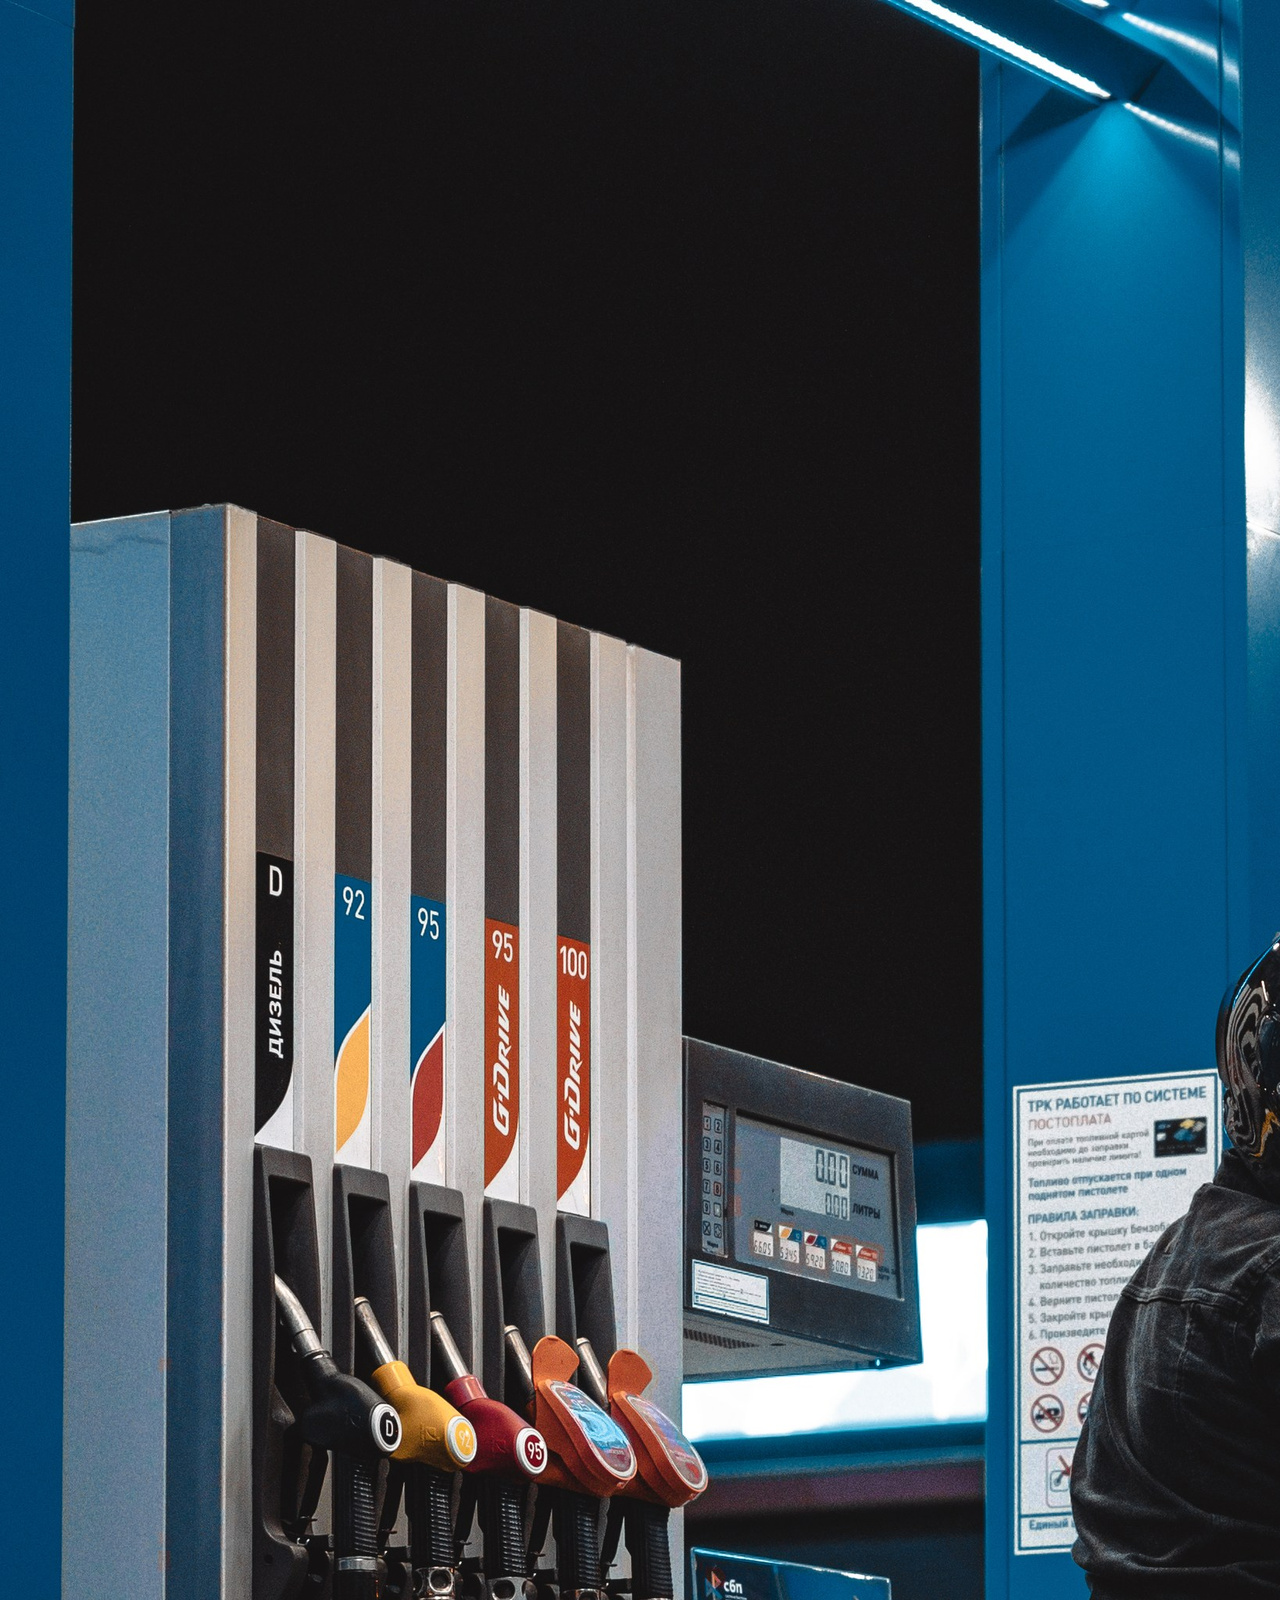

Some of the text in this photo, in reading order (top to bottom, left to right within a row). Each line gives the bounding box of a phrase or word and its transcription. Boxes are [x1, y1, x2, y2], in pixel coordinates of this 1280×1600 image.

[269, 865, 283, 897] D
[342, 886, 365, 920] 92
[417, 907, 440, 940] 95
[492, 930, 513, 963] 95
[559, 945, 588, 980] 100
[268, 950, 284, 1059] ДИЗЕЛЬ
[1028, 1086, 1207, 1113] ТРК РАБОТАЕТ ПО СИСТЕМЕ
[1028, 1113, 1112, 1131] ПОСТОПЛАТА
[815, 1149, 848, 1188] 0.00
[852, 1164, 879, 1180] СУММА
[1028, 1168, 1187, 1189] Топливо отпускается при одном
[1028, 1184, 1129, 1202] поднятом пистолете
[852, 1203, 880, 1219] ЛИТРЫ
[1028, 1206, 1140, 1224] ПРАВИЛА ЗАПРАВКИ:
[1040, 1228, 1085, 1242] Откройте
[1088, 1225, 1128, 1239] крышку
[1029, 1248, 1036, 1258] 2.
[1040, 1246, 1084, 1257] Вставьте
[1087, 1243, 1131, 1254] пистолет
[1028, 1258, 1141, 1275] 3. Заправьте необходи
[1040, 1276, 1131, 1290] количество топли
[1040, 1295, 1082, 1308] Верните
[1028, 1313, 1037, 1324] 5.
[1040, 1310, 1086, 1324] Закройте
[1040, 1326, 1105, 1340] Произведите
[385, 1419, 394, 1437] D
[459, 1431, 472, 1449] 92
[527, 1441, 543, 1461] 95
[1029, 1518, 1069, 1531] Единый
